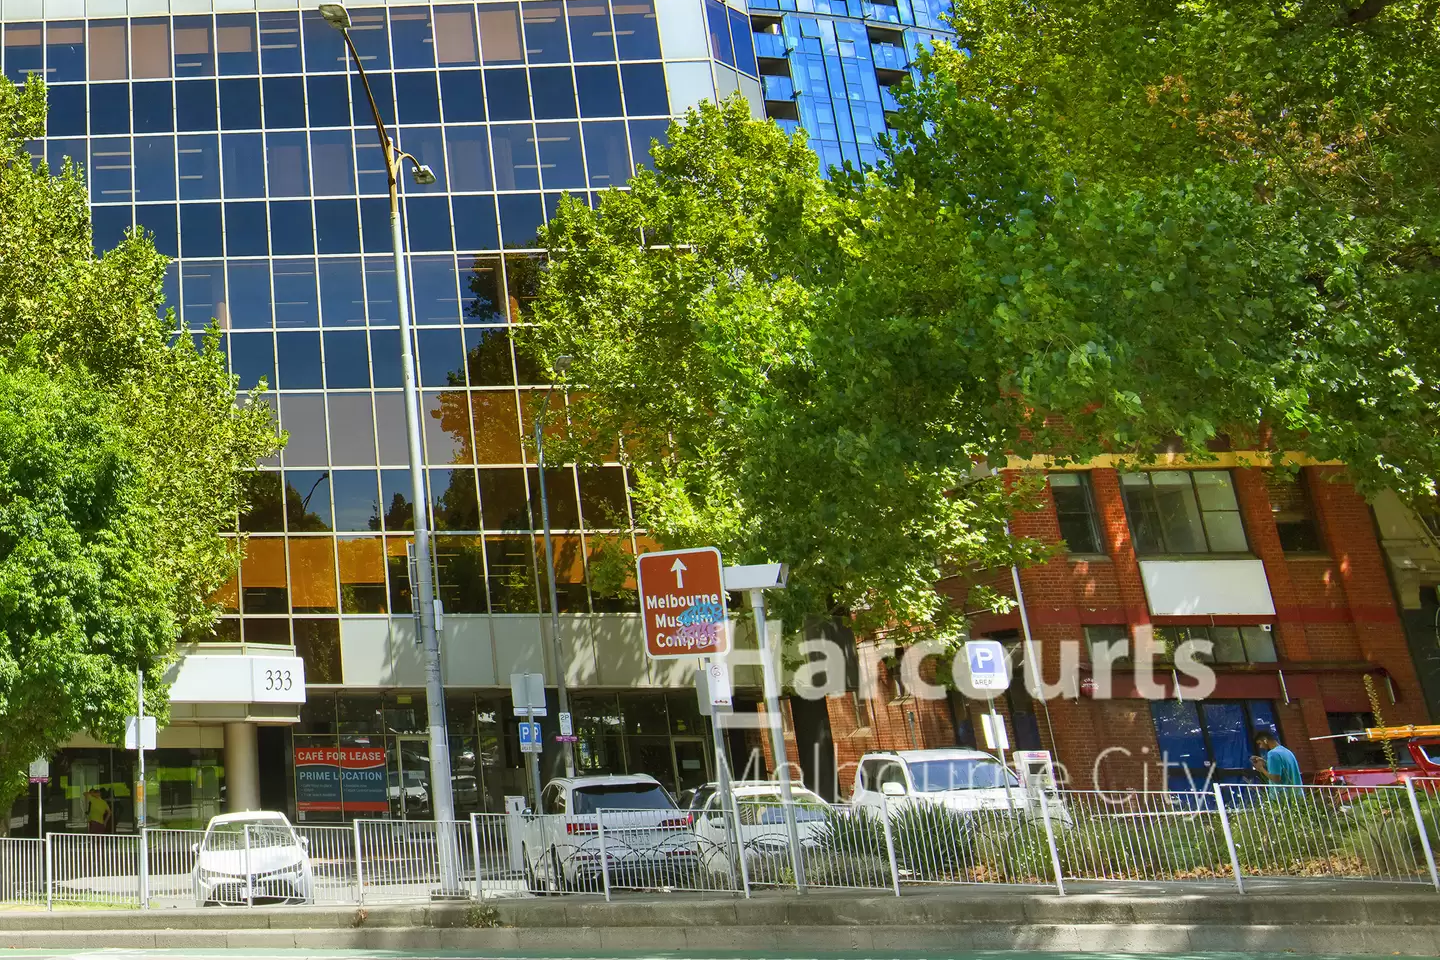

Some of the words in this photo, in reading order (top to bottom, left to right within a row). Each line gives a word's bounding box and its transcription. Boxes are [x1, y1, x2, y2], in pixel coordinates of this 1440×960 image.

[646, 592, 719, 610] Melbourne
[655, 613, 714, 629] Musum
[976, 648, 994, 669] P
[265, 669, 293, 691] 333
[522, 726, 530, 740] P
[298, 750, 324, 761] CAFÉ
[326, 751, 347, 761] FOR
[350, 751, 381, 761] LEASE
[300, 771, 331, 781] PRIME
[333, 771, 382, 781] LOCATION
